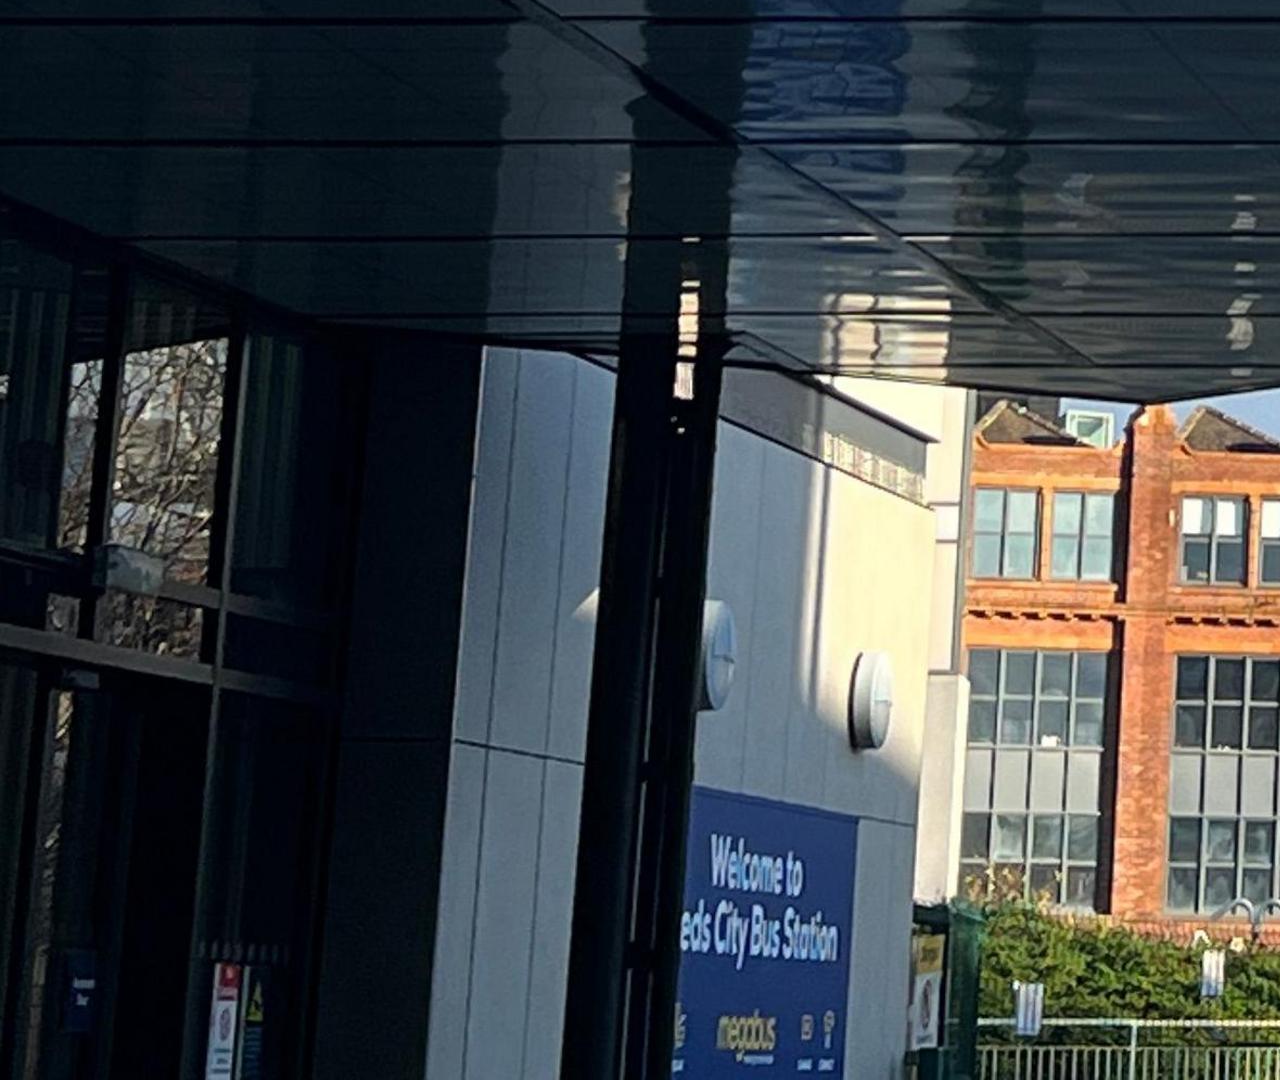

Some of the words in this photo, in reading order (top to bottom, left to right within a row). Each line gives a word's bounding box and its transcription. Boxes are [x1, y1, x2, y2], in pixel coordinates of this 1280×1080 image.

[710, 833, 784, 895] Welcome
[786, 850, 803, 897] to
[680, 898, 712, 953] eds
[714, 899, 750, 970] City
[750, 903, 781, 958] Bus
[782, 906, 839, 962] Station
